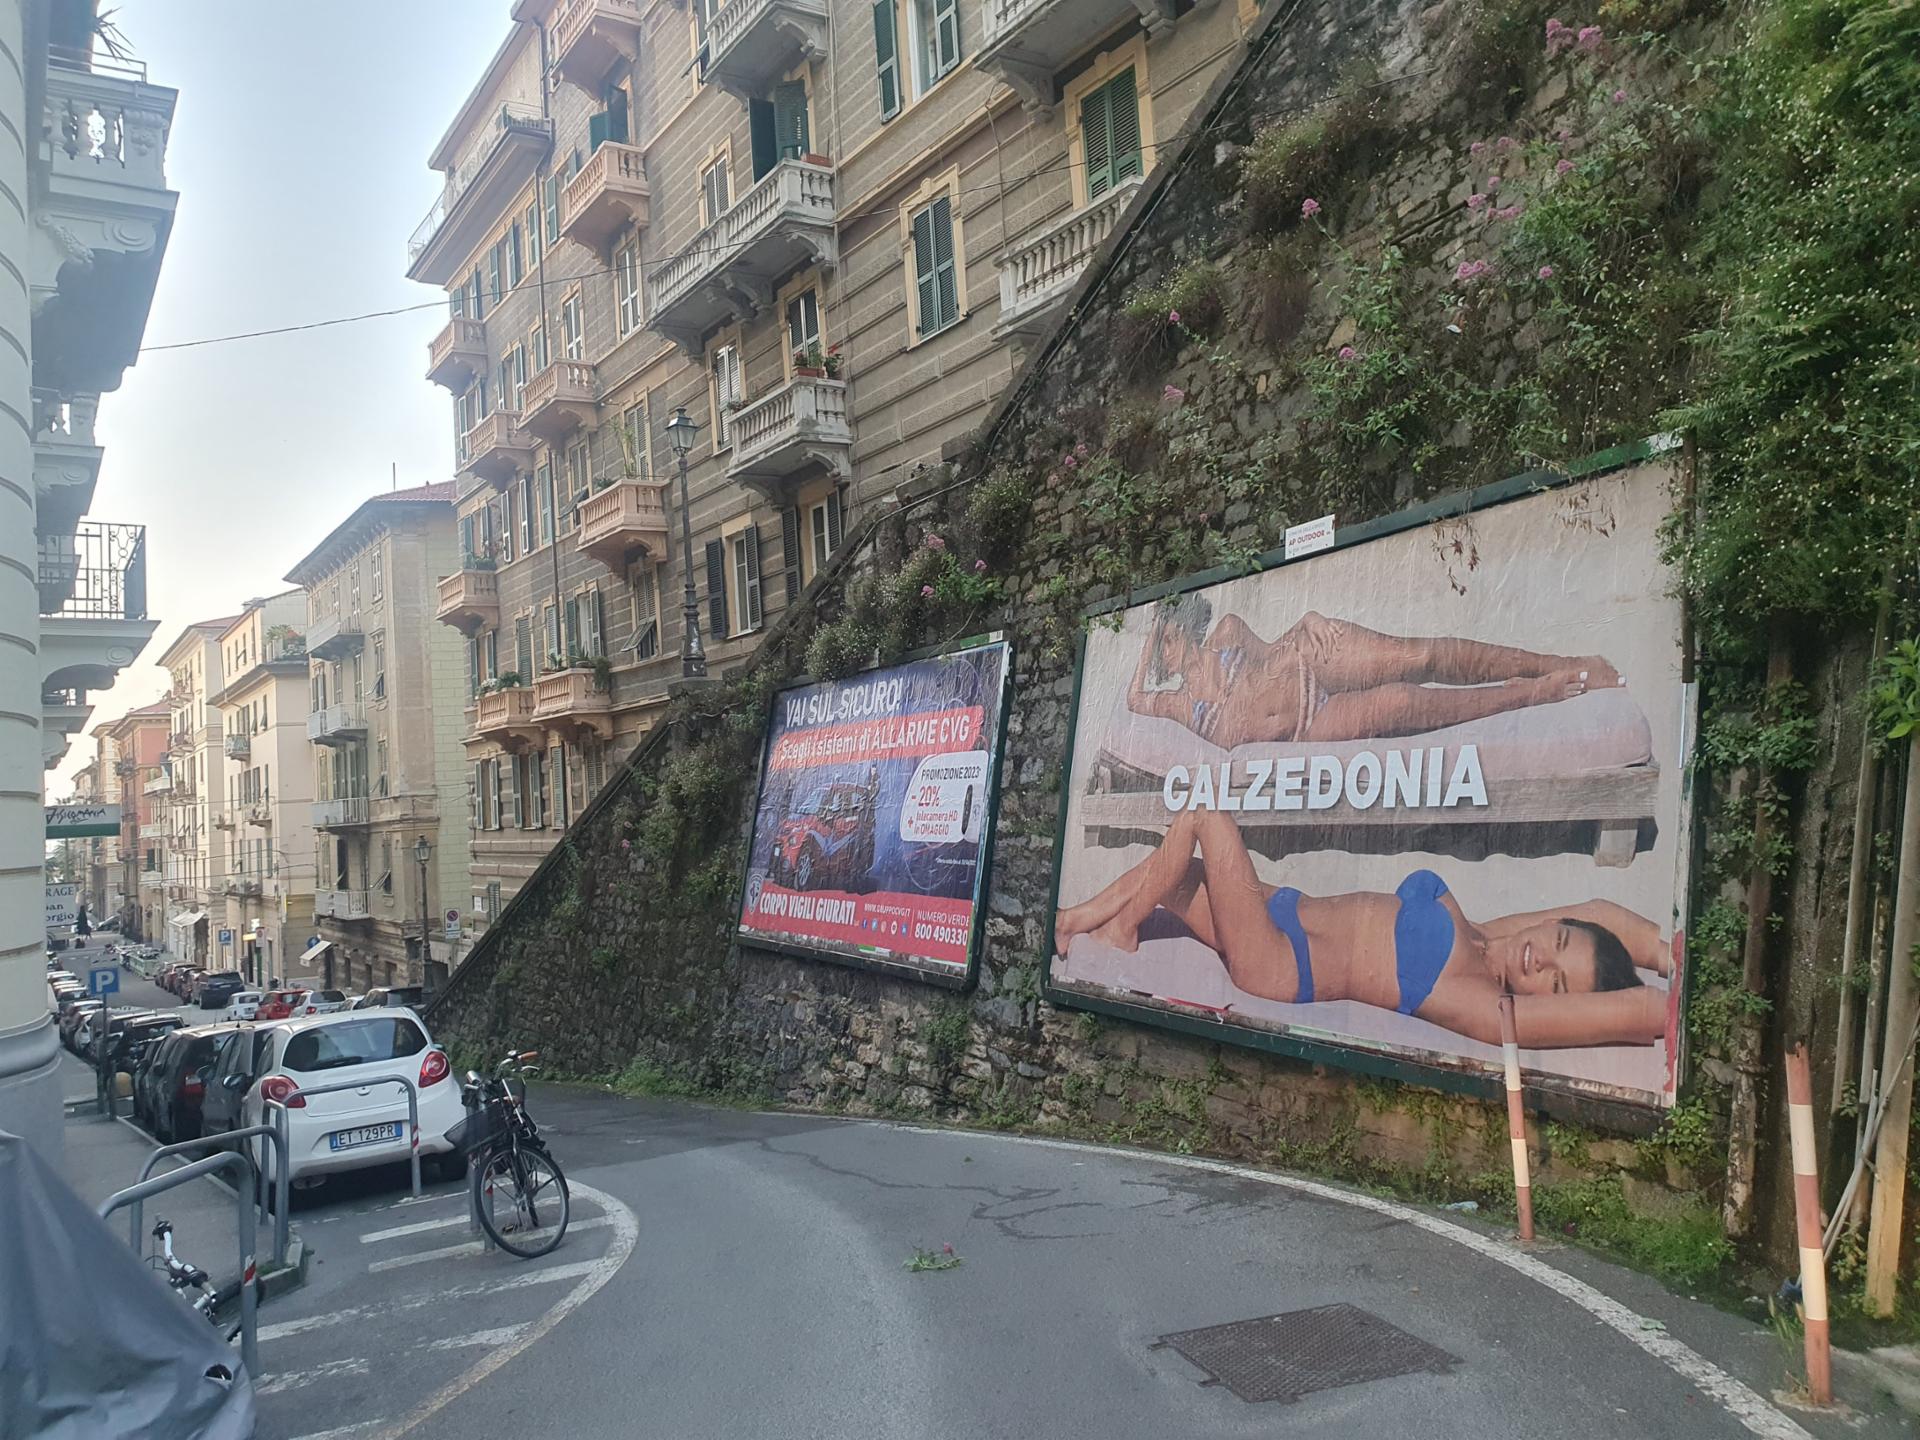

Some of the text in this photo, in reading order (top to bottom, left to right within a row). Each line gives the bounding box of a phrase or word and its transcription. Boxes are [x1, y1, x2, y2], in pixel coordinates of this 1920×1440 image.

[1297, 530, 1325, 544] OUTDOOR
[786, 677, 904, 728] VAI SUL SICURO!
[817, 731, 857, 756] sistemi
[859, 727, 871, 750] di
[872, 718, 938, 750] ALLARME
[941, 714, 970, 744] CVG
[921, 767, 964, 781] PROMOZIONE
[1162, 744, 1489, 812] CALZEDONIA
[918, 785, 941, 807] 20%
[948, 810, 958, 821] HD
[920, 823, 949, 836] OMAGGIO
[760, 892, 856, 926] CORPO VIGILI GIURATI
[917, 910, 947, 924] NUMERO
[914, 922, 969, 946] 800 490330
[96, 971, 115, 992] P
[338, 1124, 394, 1145] ET 129PR
